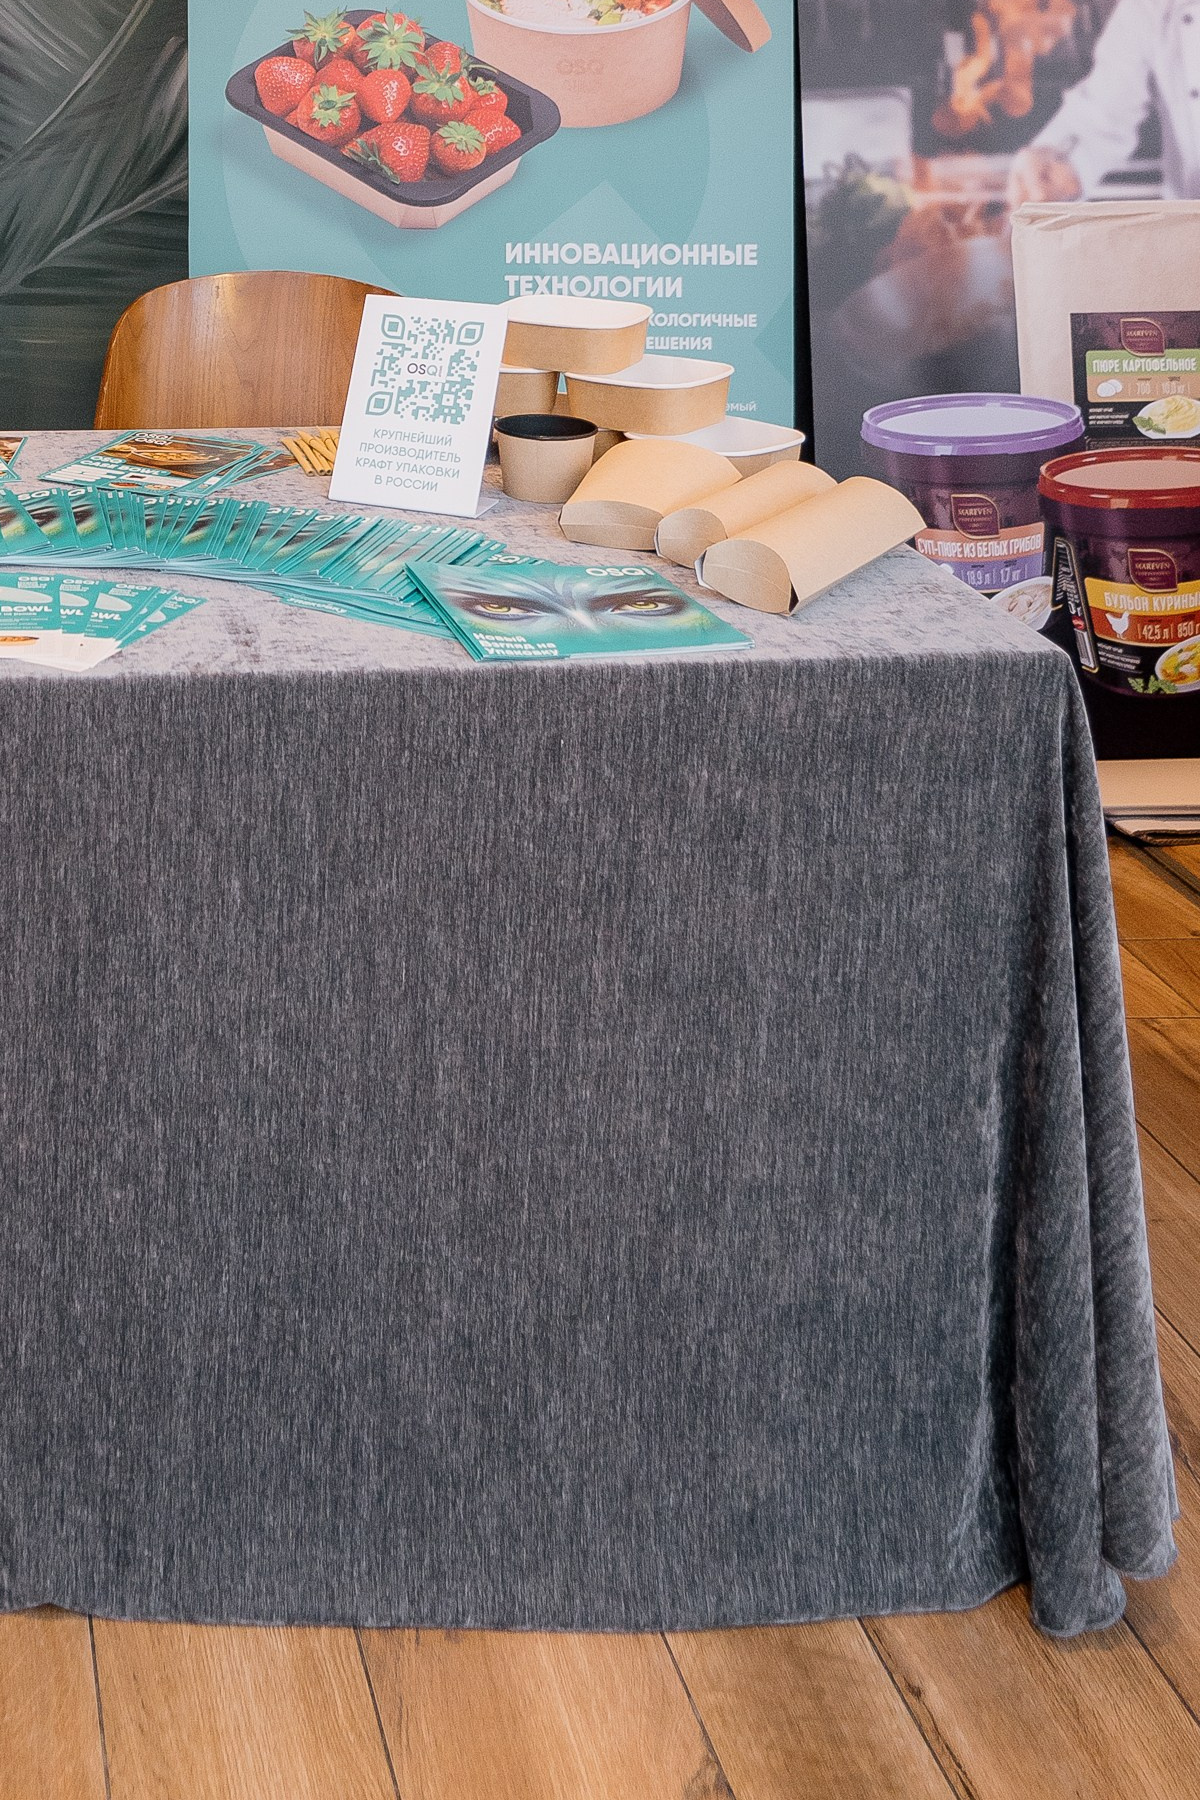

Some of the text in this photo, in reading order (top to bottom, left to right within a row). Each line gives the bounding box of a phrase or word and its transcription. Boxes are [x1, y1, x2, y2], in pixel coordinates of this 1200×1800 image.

[505, 242, 759, 269] ИННОВАЦИОННЫЕ
[504, 275, 683, 298] ТЕХНОЛОГИИ
[645, 336, 713, 350] ЕШЕНИЯ
[407, 362, 438, 377] OSQ
[1092, 357, 1198, 373] ПЮРЕ КАРТОФЕЛЬНОЕ
[373, 428, 453, 447] КРУПНЕЙШИЙ
[359, 442, 462, 463] ПРОИЗВОДИТЕЛЬ
[355, 457, 461, 479] КРАФТ УПАКОВКИ
[374, 474, 439, 492] В РОССИИ
[917, 533, 1042, 558] СУП-ПЮРЕ ИЗ БЕЛЫХ ГРИБОВ
[585, 568, 646, 577] OSQ
[0, 605, 53, 613] BOWL
[1104, 591, 1149, 612] БУЛЬОН
[473, 632, 527, 643] Новый
[1142, 624, 1160, 641] 42,5
[1177, 621, 1194, 638] 850
[480, 641, 534, 650] Взгляд
[487, 648, 559, 656] Упаковку
